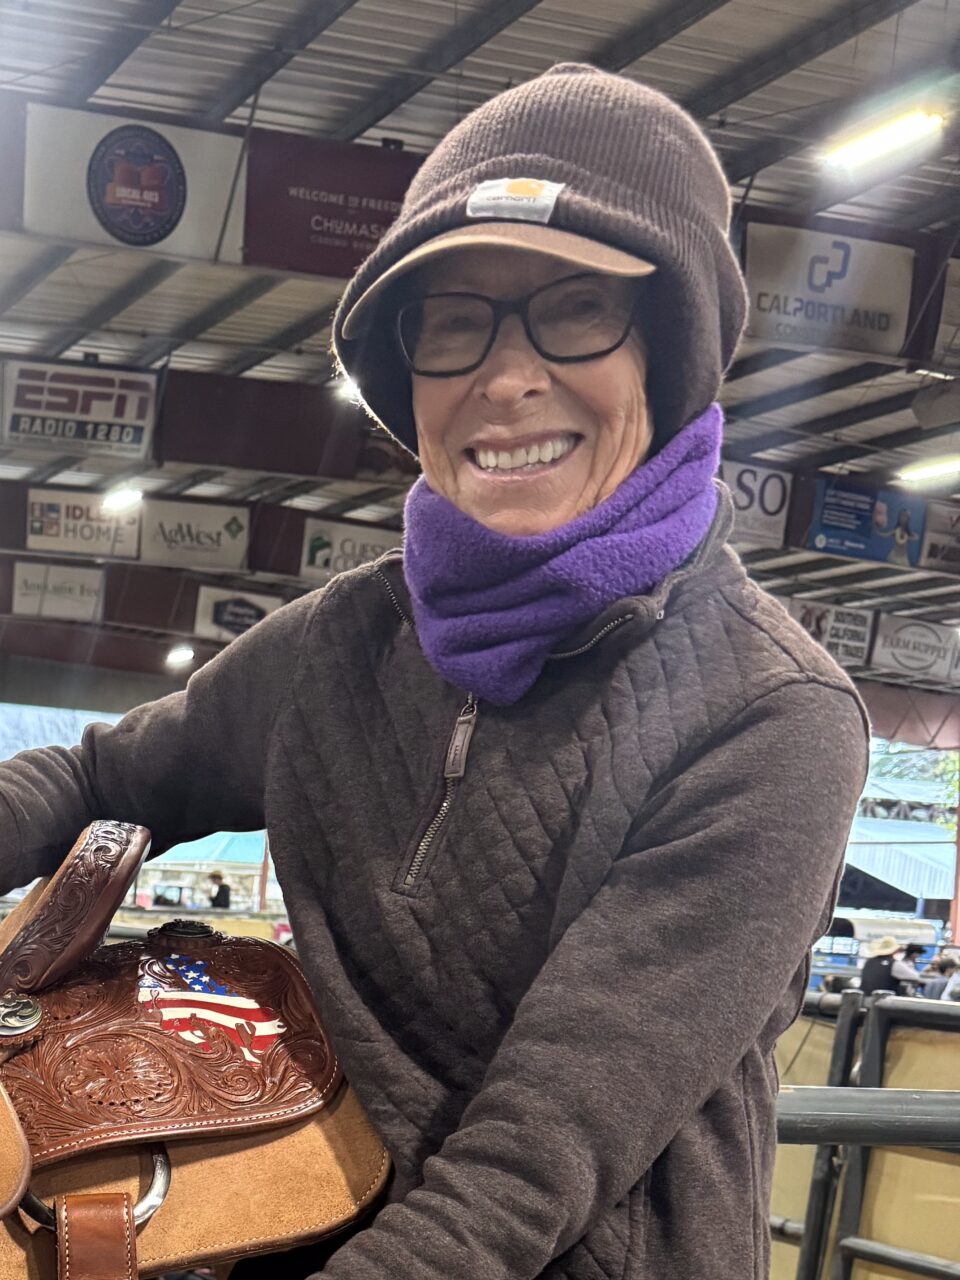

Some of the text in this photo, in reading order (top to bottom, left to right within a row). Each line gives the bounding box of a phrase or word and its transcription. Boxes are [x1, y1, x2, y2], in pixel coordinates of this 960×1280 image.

[288, 187, 345, 206] WELCOME
[13, 368, 155, 421] ESPN
[19, 416, 134, 443] RADIO 1280
[64, 522, 126, 545] HOME
